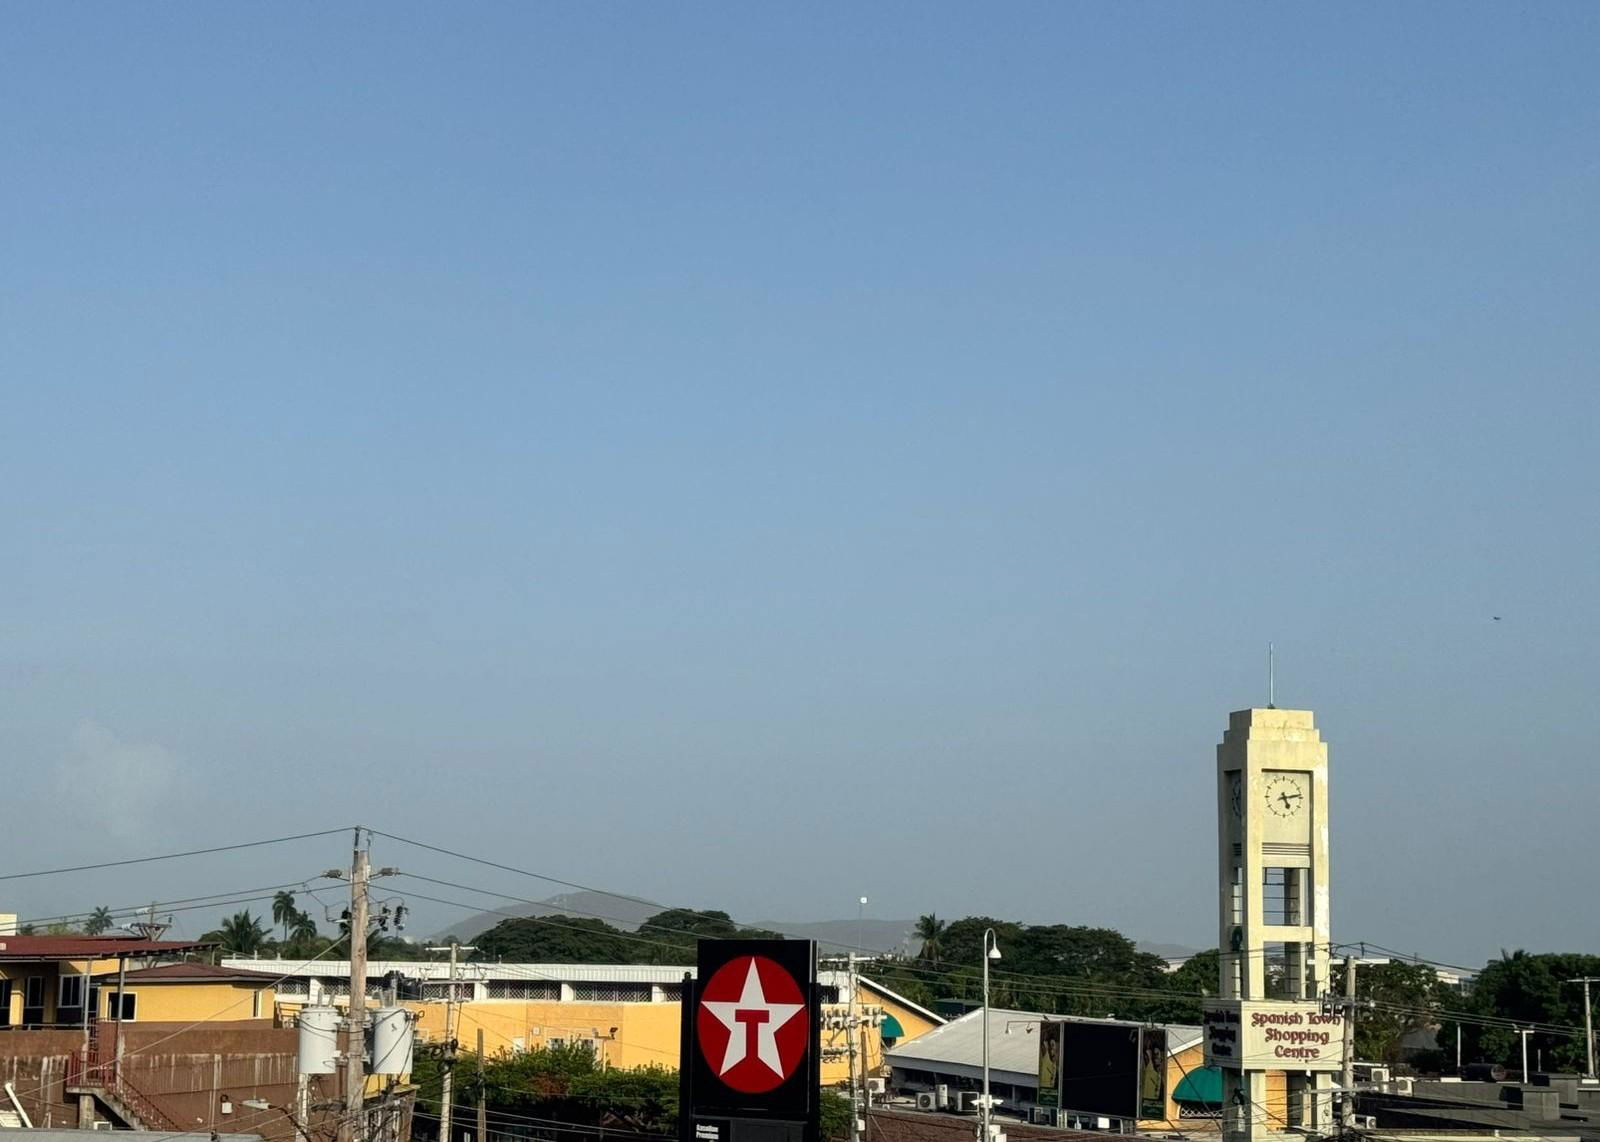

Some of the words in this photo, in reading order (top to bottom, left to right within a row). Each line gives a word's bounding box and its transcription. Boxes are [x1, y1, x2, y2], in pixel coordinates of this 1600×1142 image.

[1251, 1012, 1303, 1027] Spanish
[1306, 1012, 1340, 1025] Town
[735, 1010, 769, 1058] T
[1265, 1028, 1330, 1045] Shopping
[1274, 1045, 1320, 1059] Centre
